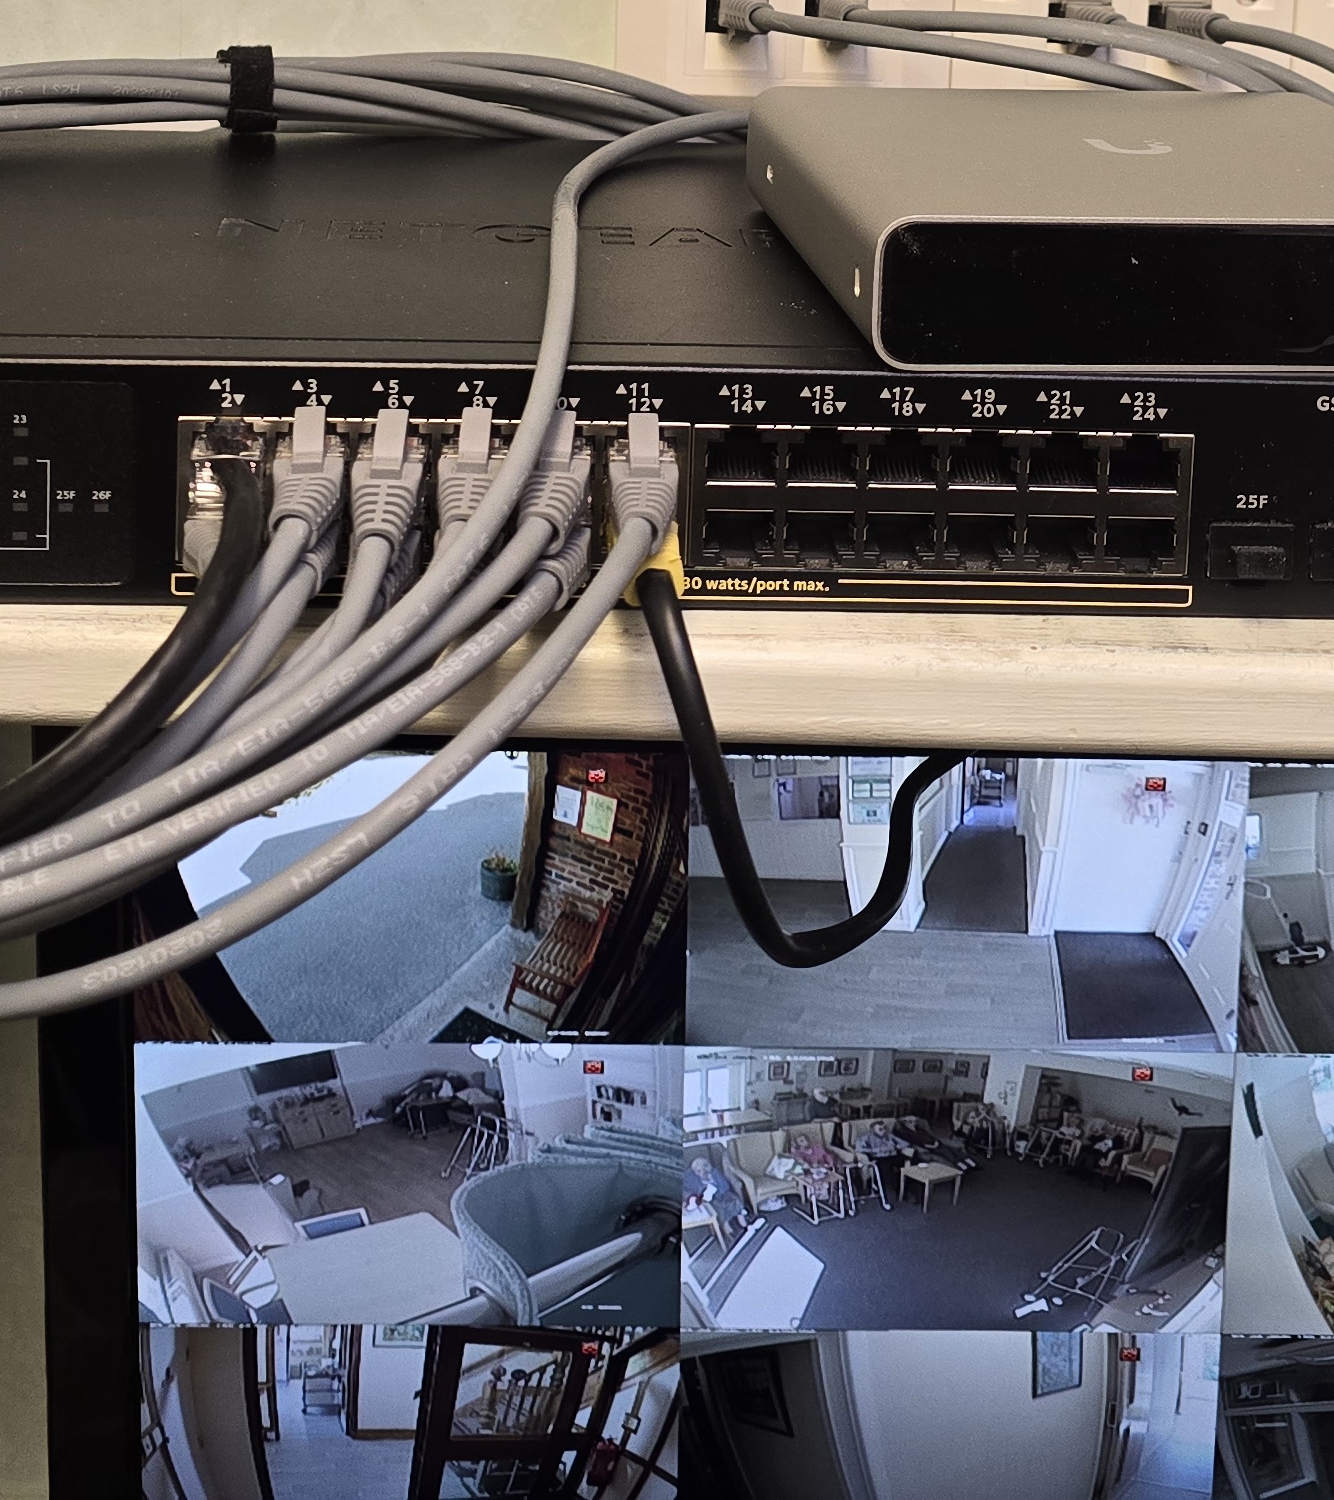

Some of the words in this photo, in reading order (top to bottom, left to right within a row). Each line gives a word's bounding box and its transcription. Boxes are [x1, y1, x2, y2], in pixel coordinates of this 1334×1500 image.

[221, 377, 231, 392] 1
[306, 378, 318, 393] 3
[388, 379, 400, 394] 5
[472, 380, 485, 395] 7
[629, 382, 649, 397] 11
[729, 384, 753, 399] 13
[810, 385, 834, 400] 15
[890, 386, 915, 401] 17
[971, 388, 996, 403] 19
[1048, 390, 1071, 404] 21
[1132, 391, 1156, 406] 23
[220, 392, 233, 408] 2
[305, 393, 318, 407] 4
[387, 394, 399, 409] 6
[472, 395, 484, 408] 8
[628, 397, 651, 412] 12
[731, 399, 754, 414] 14
[811, 400, 834, 415] 16
[891, 401, 914, 416] 18
[971, 403, 995, 418] 20
[1049, 404, 1072, 419] 22
[1132, 406, 1156, 421] 24
[12, 414, 27, 424] 23
[12, 489, 27, 499] 24
[56, 490, 76, 500] 25F
[91, 490, 112, 500] 26F
[1235, 494, 1269, 509] 25F
[705, 576, 790, 595] watts/port
[793, 580, 830, 592] max.
[104, 834, 158, 862] ETL
[164, 772, 282, 837] VERIFIED
[297, 744, 329, 773] TO
[101, 800, 141, 829] TO
